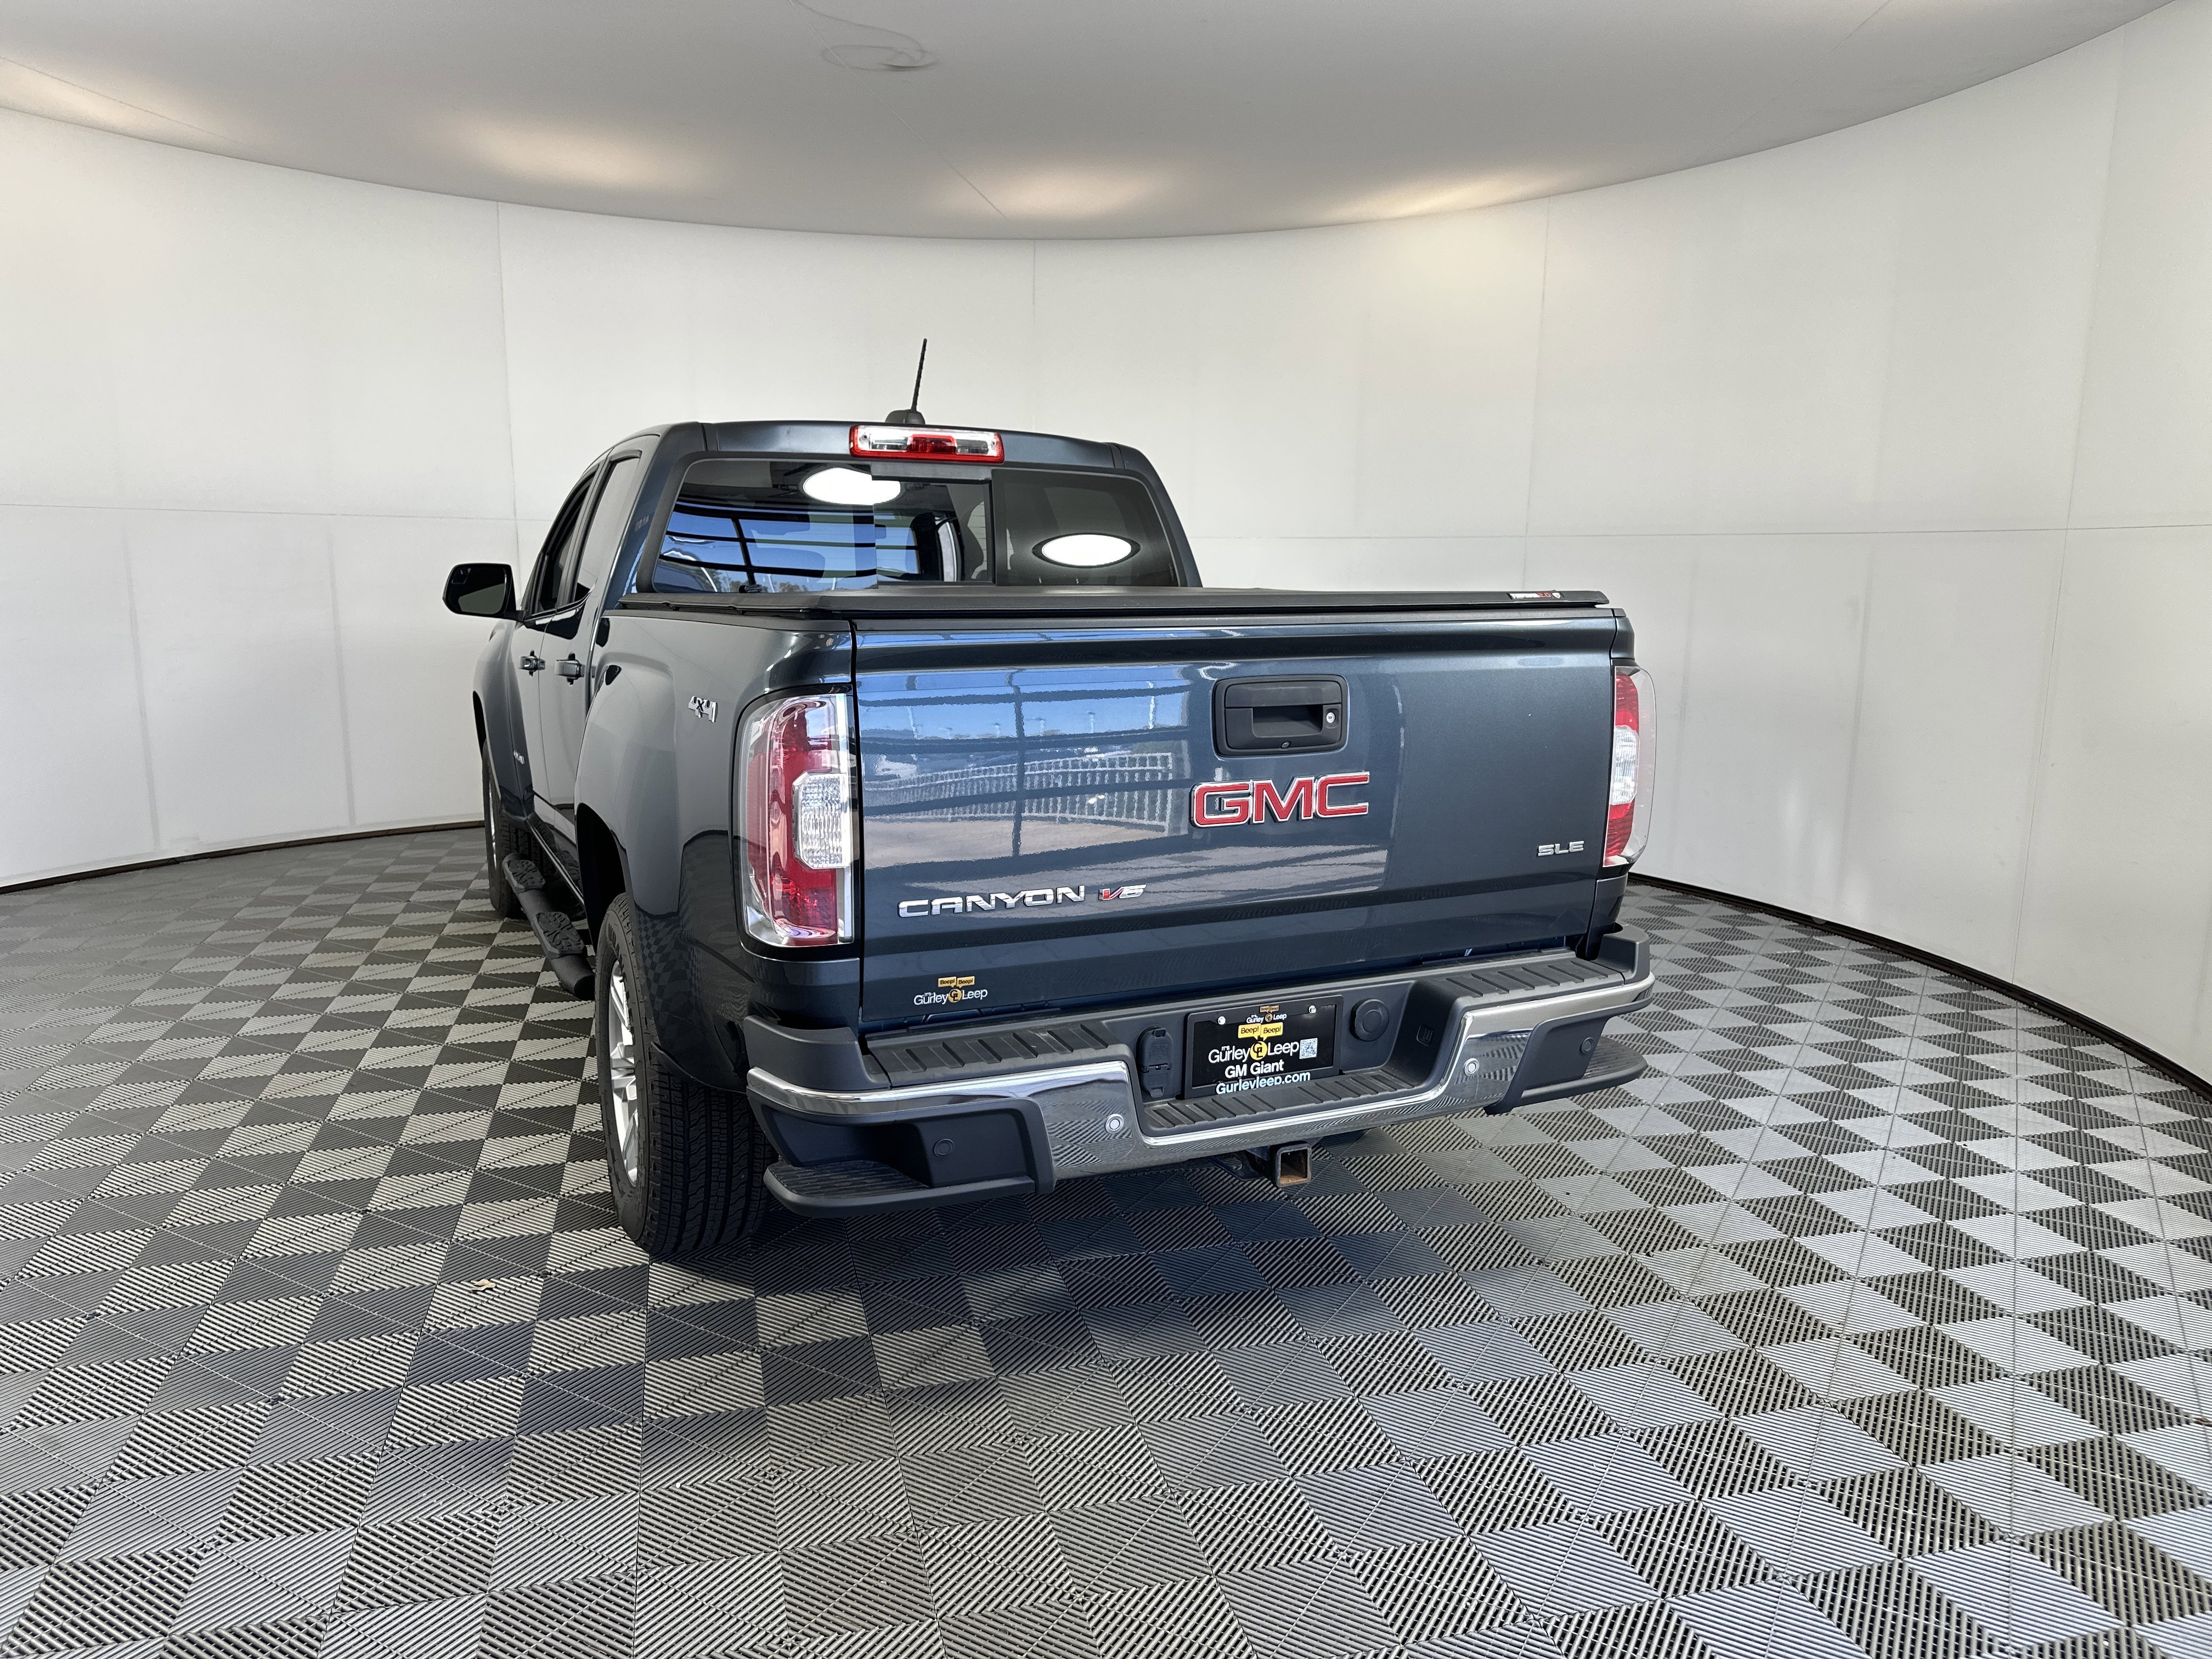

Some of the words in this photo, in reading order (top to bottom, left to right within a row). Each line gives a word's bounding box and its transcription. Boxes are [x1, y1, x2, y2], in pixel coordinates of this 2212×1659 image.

[1190, 771, 1370, 828] GMC
[1537, 840, 1584, 856] SLE
[898, 885, 1085, 918] CANYON
[1098, 884, 1147, 900] V6
[962, 989, 988, 1000] Leep
[1241, 1026, 1259, 1034] Beep!
[1263, 1026, 1281, 1034] Beep!
[1267, 1041, 1300, 1056] Leep
[1224, 1064, 1247, 1079] GM
[1250, 1059, 1285, 1075] Giant
